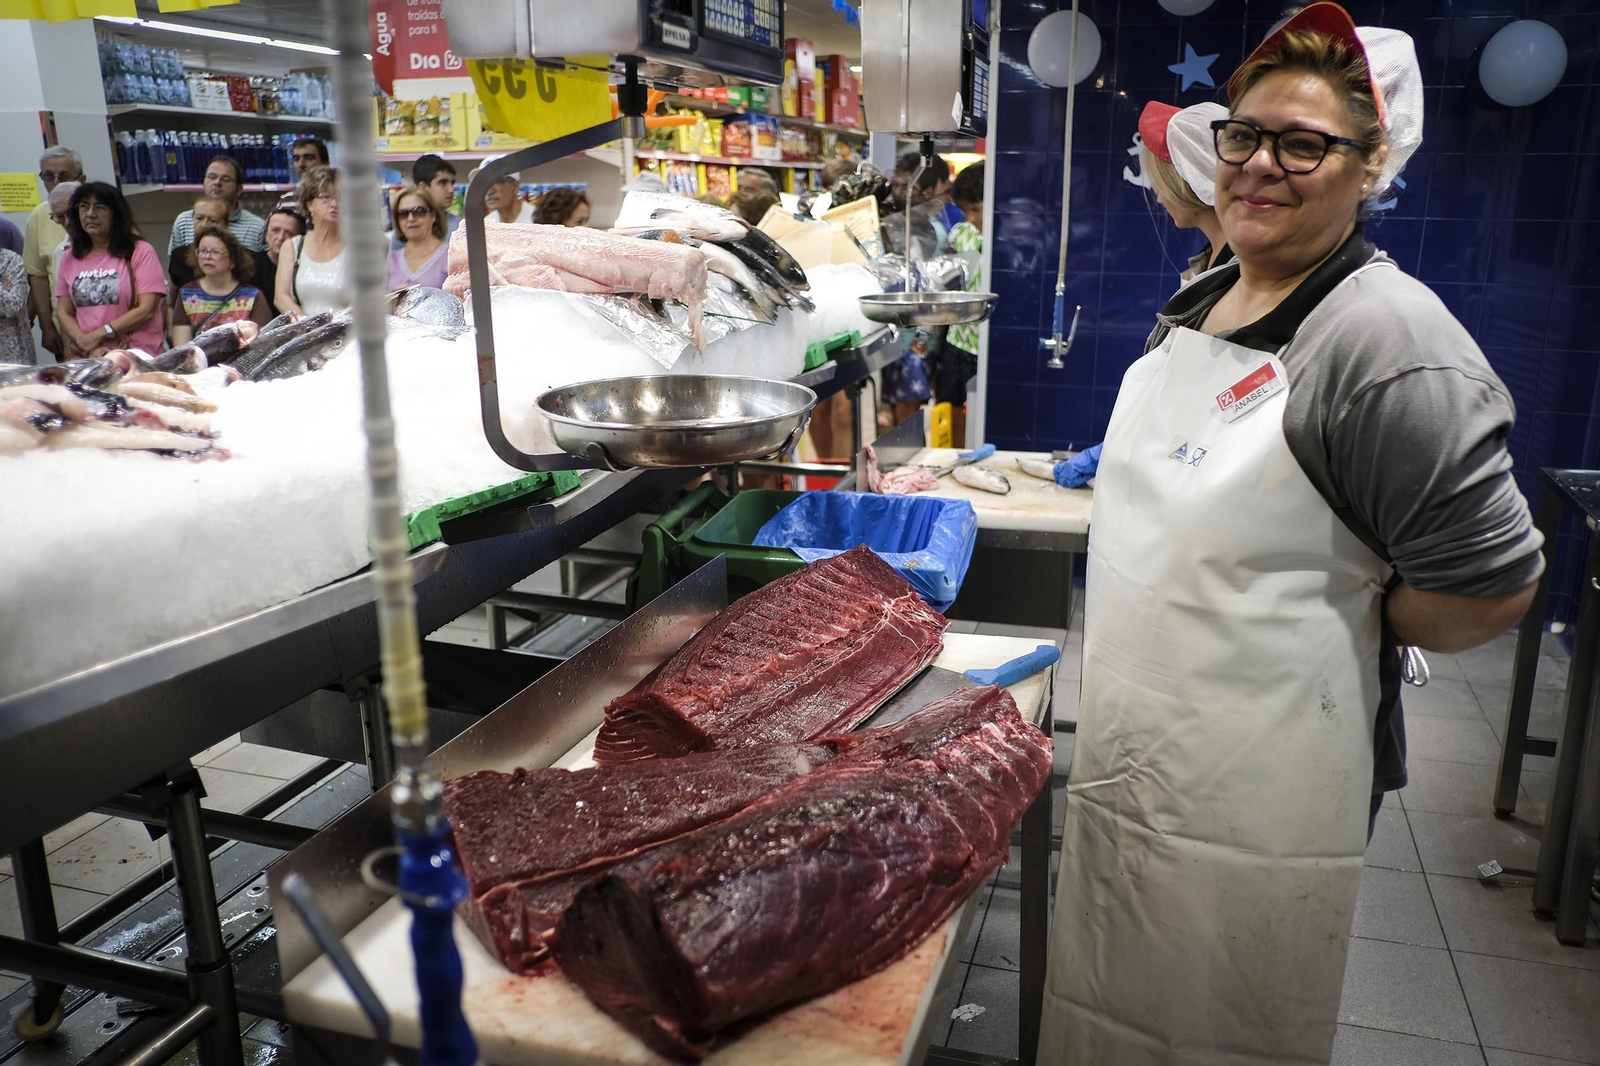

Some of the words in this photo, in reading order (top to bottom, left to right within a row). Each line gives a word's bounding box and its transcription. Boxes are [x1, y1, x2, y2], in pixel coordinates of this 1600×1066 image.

[376, 11, 392, 56] Agua
[408, 25, 430, 38] para
[431, 23, 438, 34] ti
[1234, 386, 1269, 412] ANABEL
